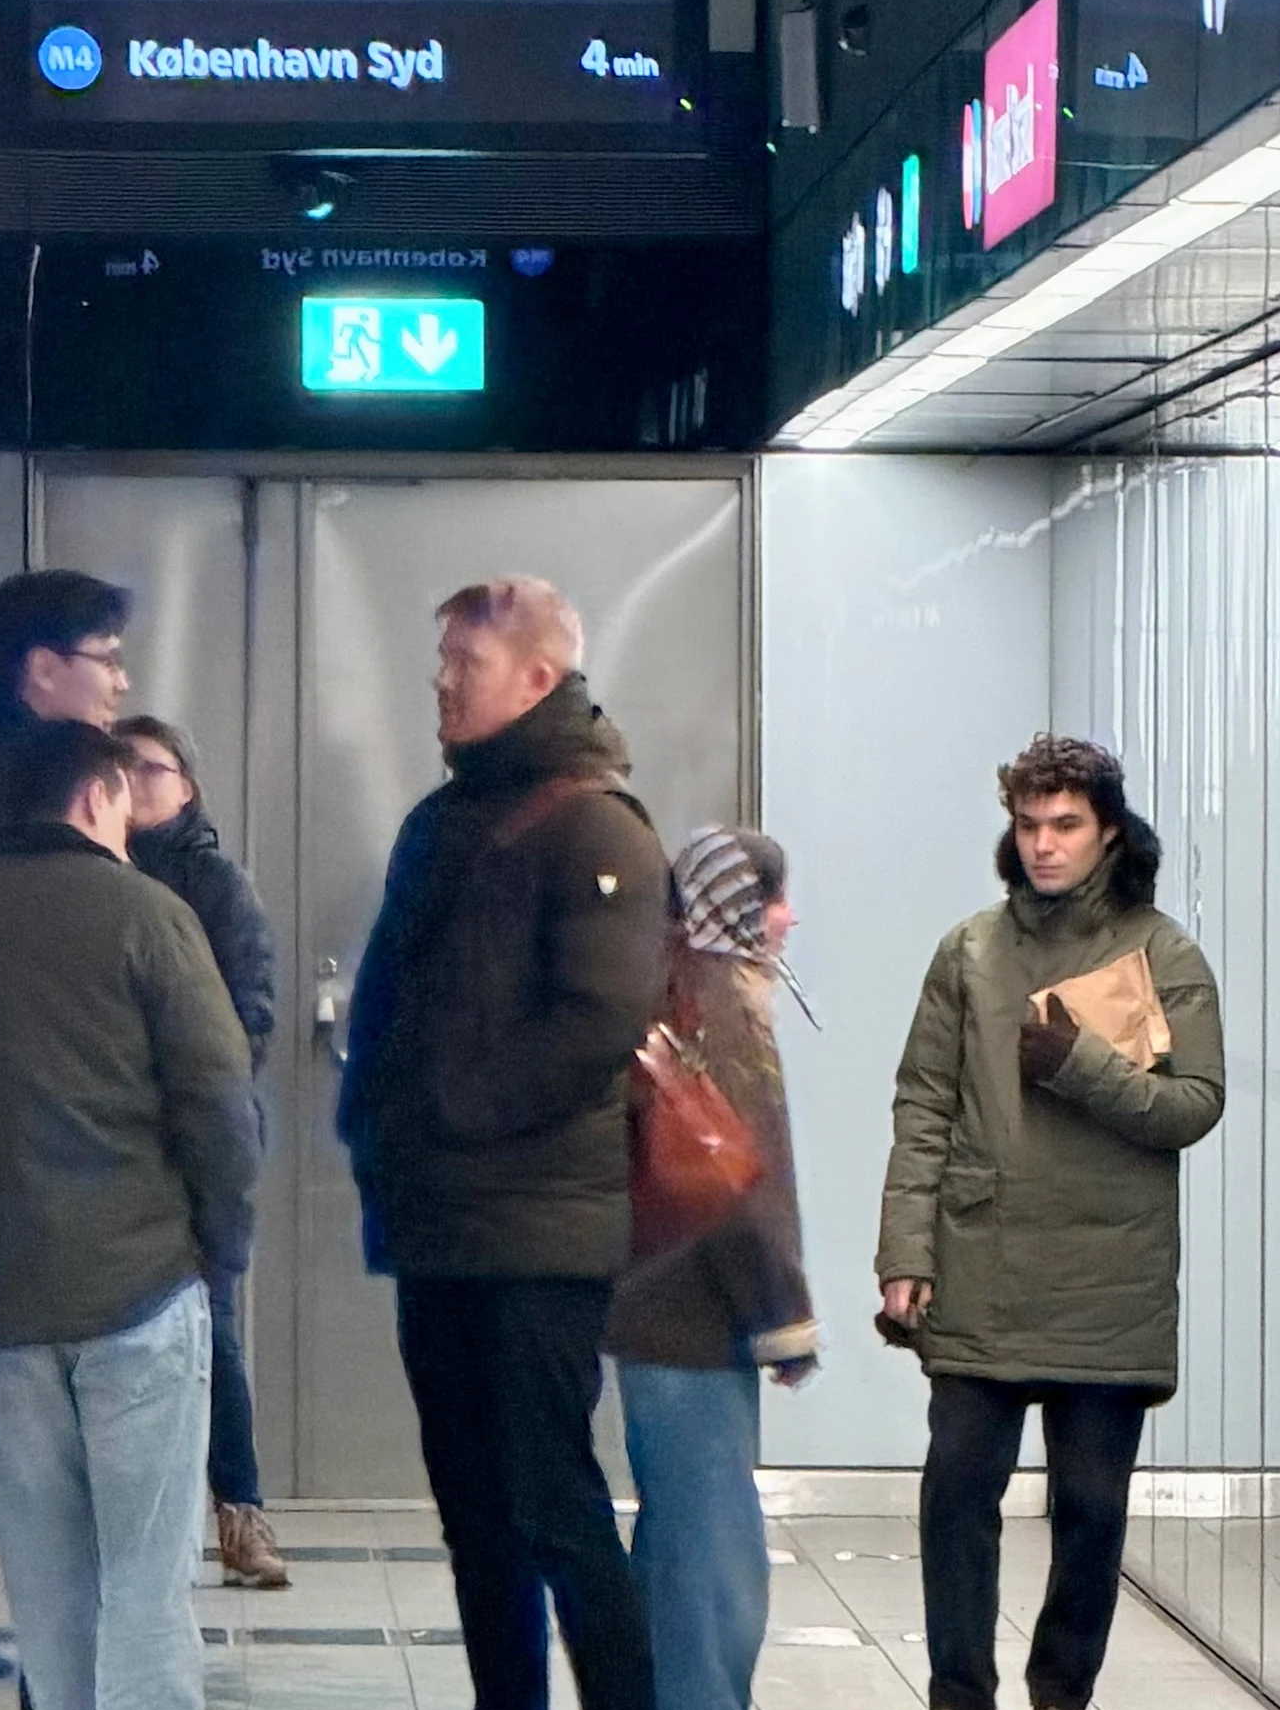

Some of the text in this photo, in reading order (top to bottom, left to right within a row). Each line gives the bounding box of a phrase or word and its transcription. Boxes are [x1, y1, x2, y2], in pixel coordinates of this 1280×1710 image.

[47, 45, 94, 71] M4
[129, 37, 444, 89] København Syd
[580, 39, 660, 77] 4 min
